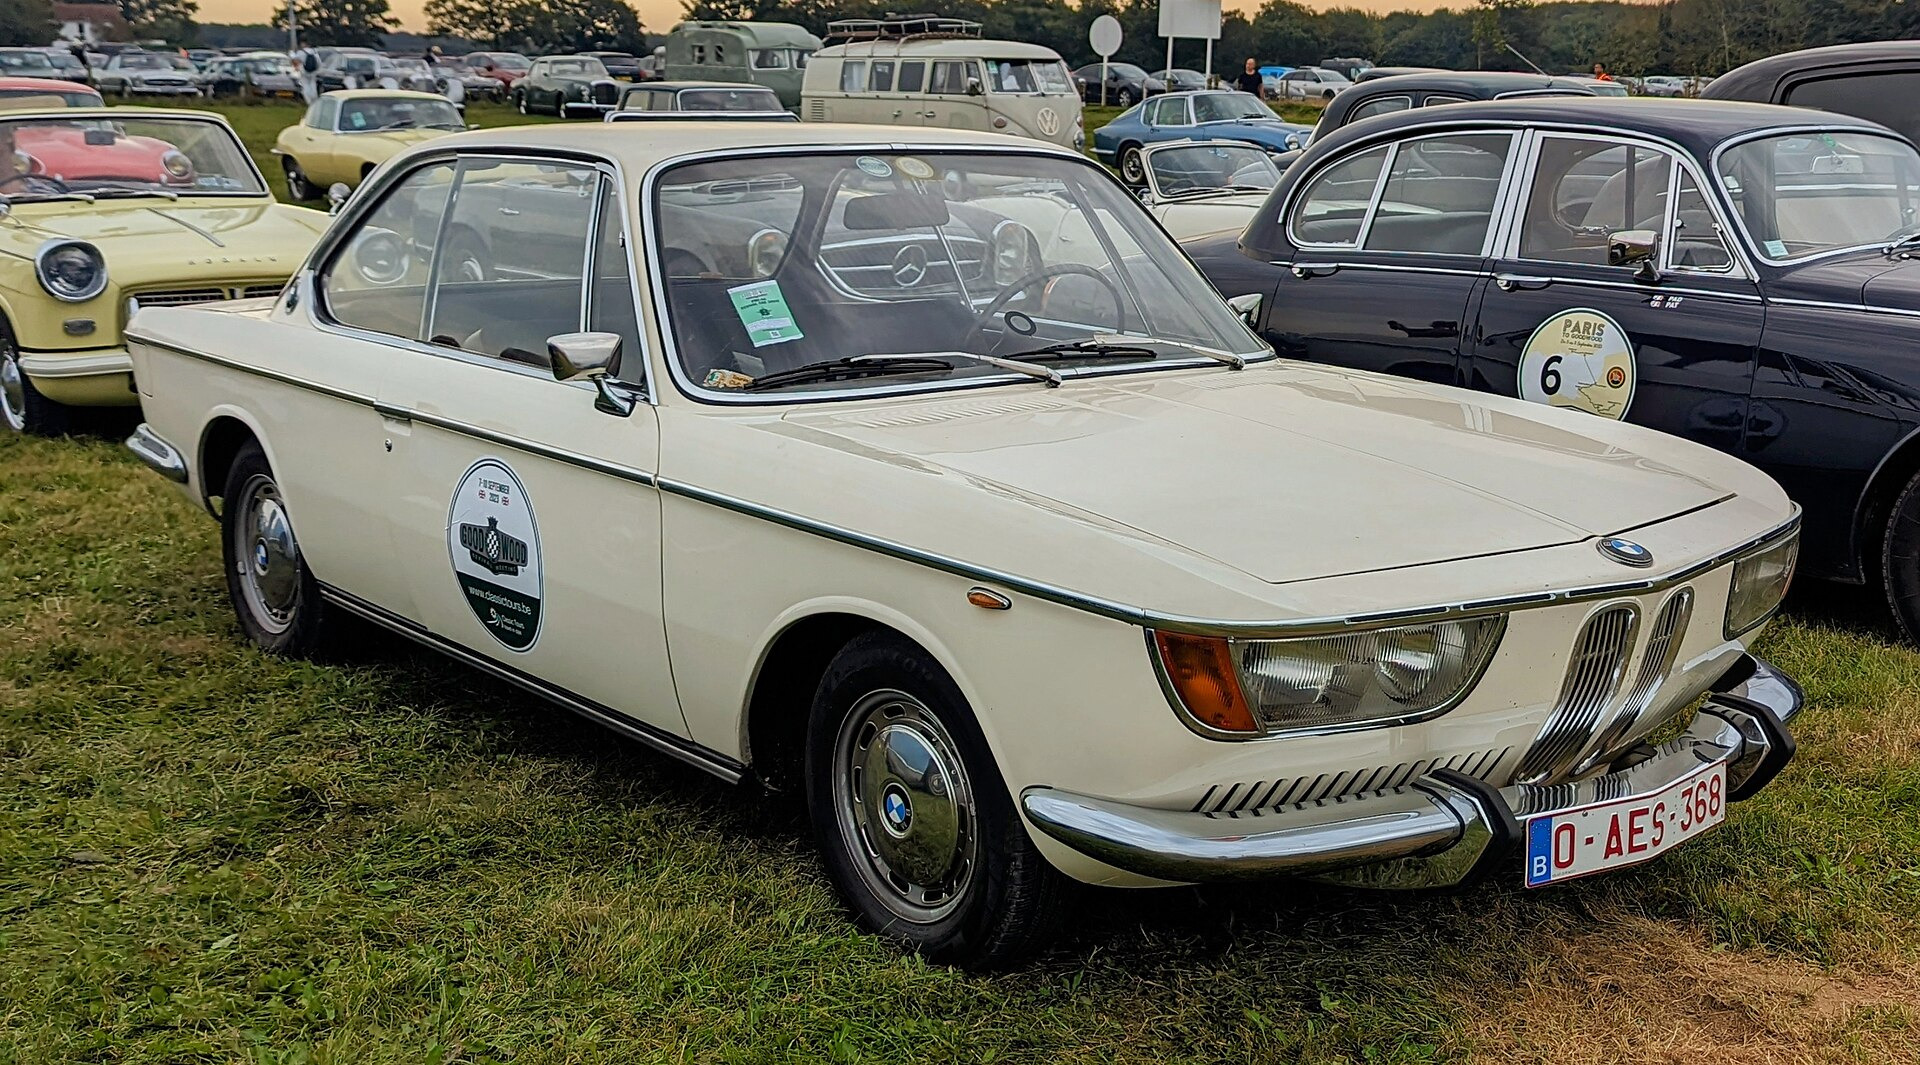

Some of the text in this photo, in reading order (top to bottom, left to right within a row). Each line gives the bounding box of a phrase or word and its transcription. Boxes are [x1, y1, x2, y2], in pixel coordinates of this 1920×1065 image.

[1562, 319, 1605, 336] PARIS
[1541, 355, 1563, 395] 6
[468, 586, 532, 615] www.classictours.be
[1533, 855, 1548, 877] B
